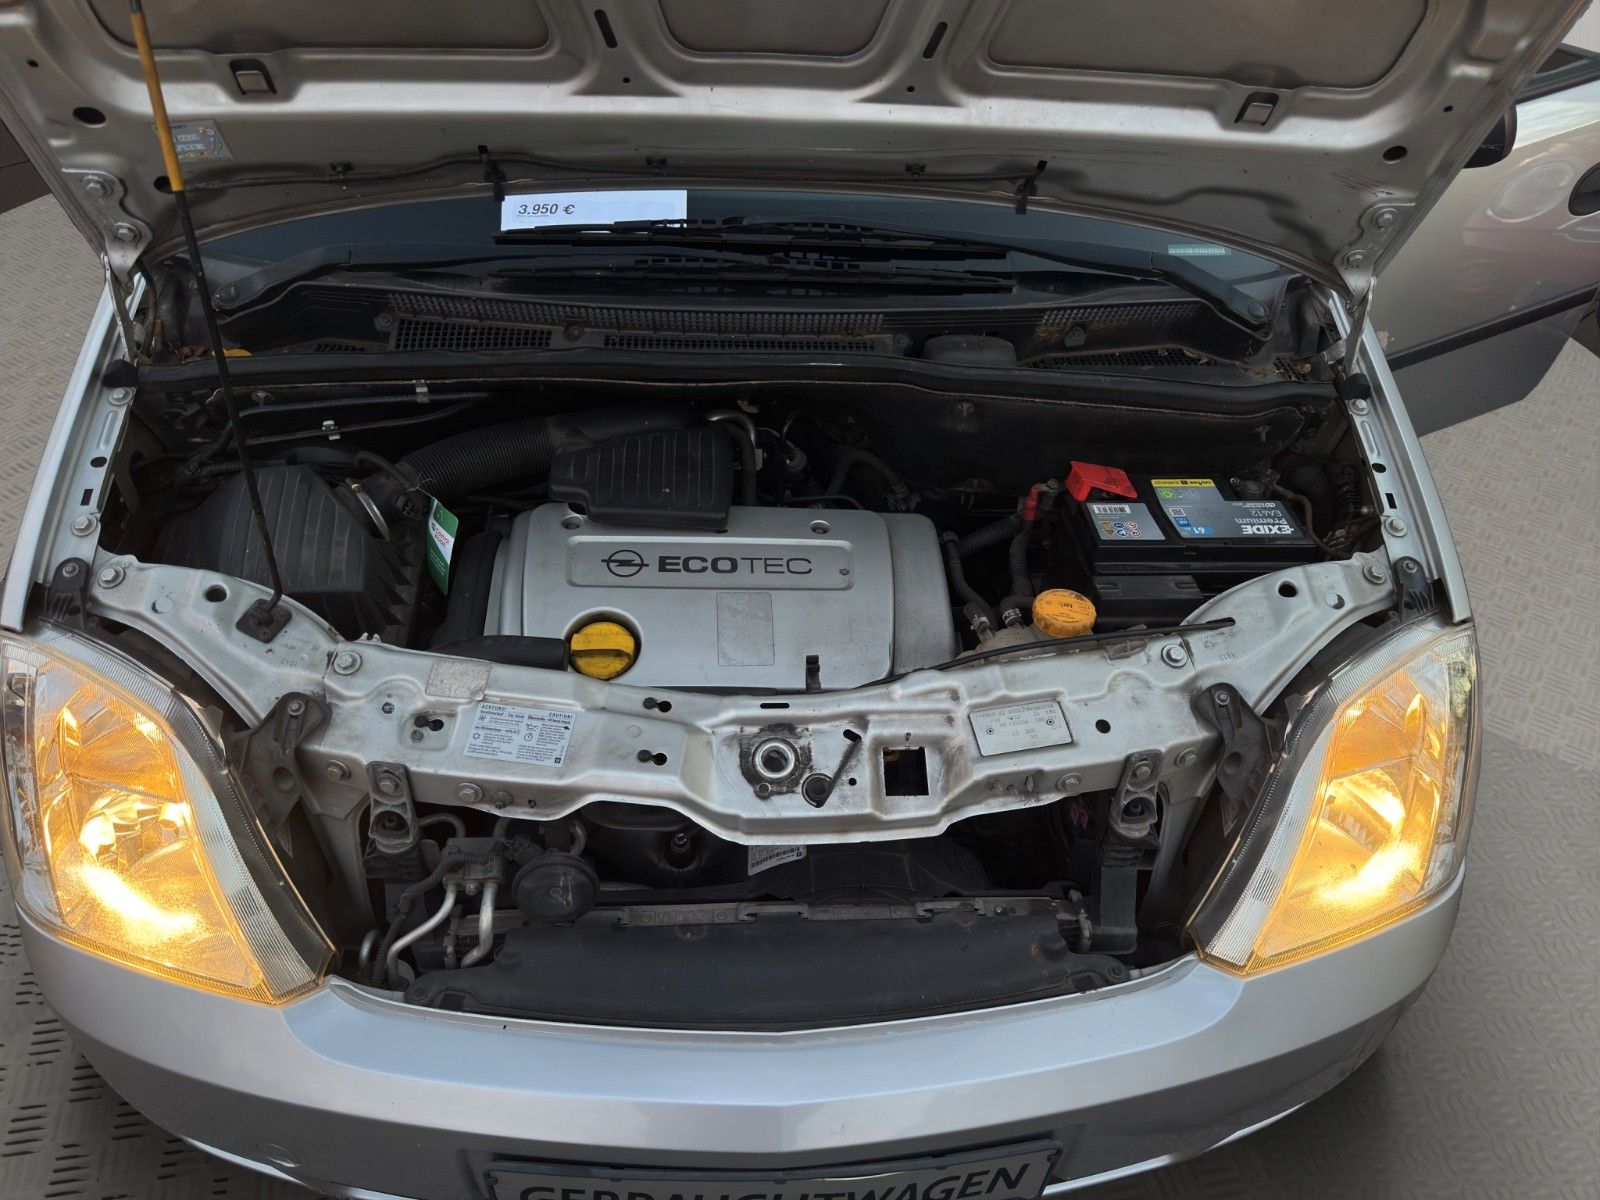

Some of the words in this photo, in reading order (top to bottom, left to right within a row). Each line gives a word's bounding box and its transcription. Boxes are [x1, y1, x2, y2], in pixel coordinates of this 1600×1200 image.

[518, 203, 559, 215] 3.950
[562, 204, 575, 215] €
[1235, 517, 1288, 525] Premium
[1242, 524, 1294, 535] EXIDE
[657, 555, 813, 575] ECOTEC
